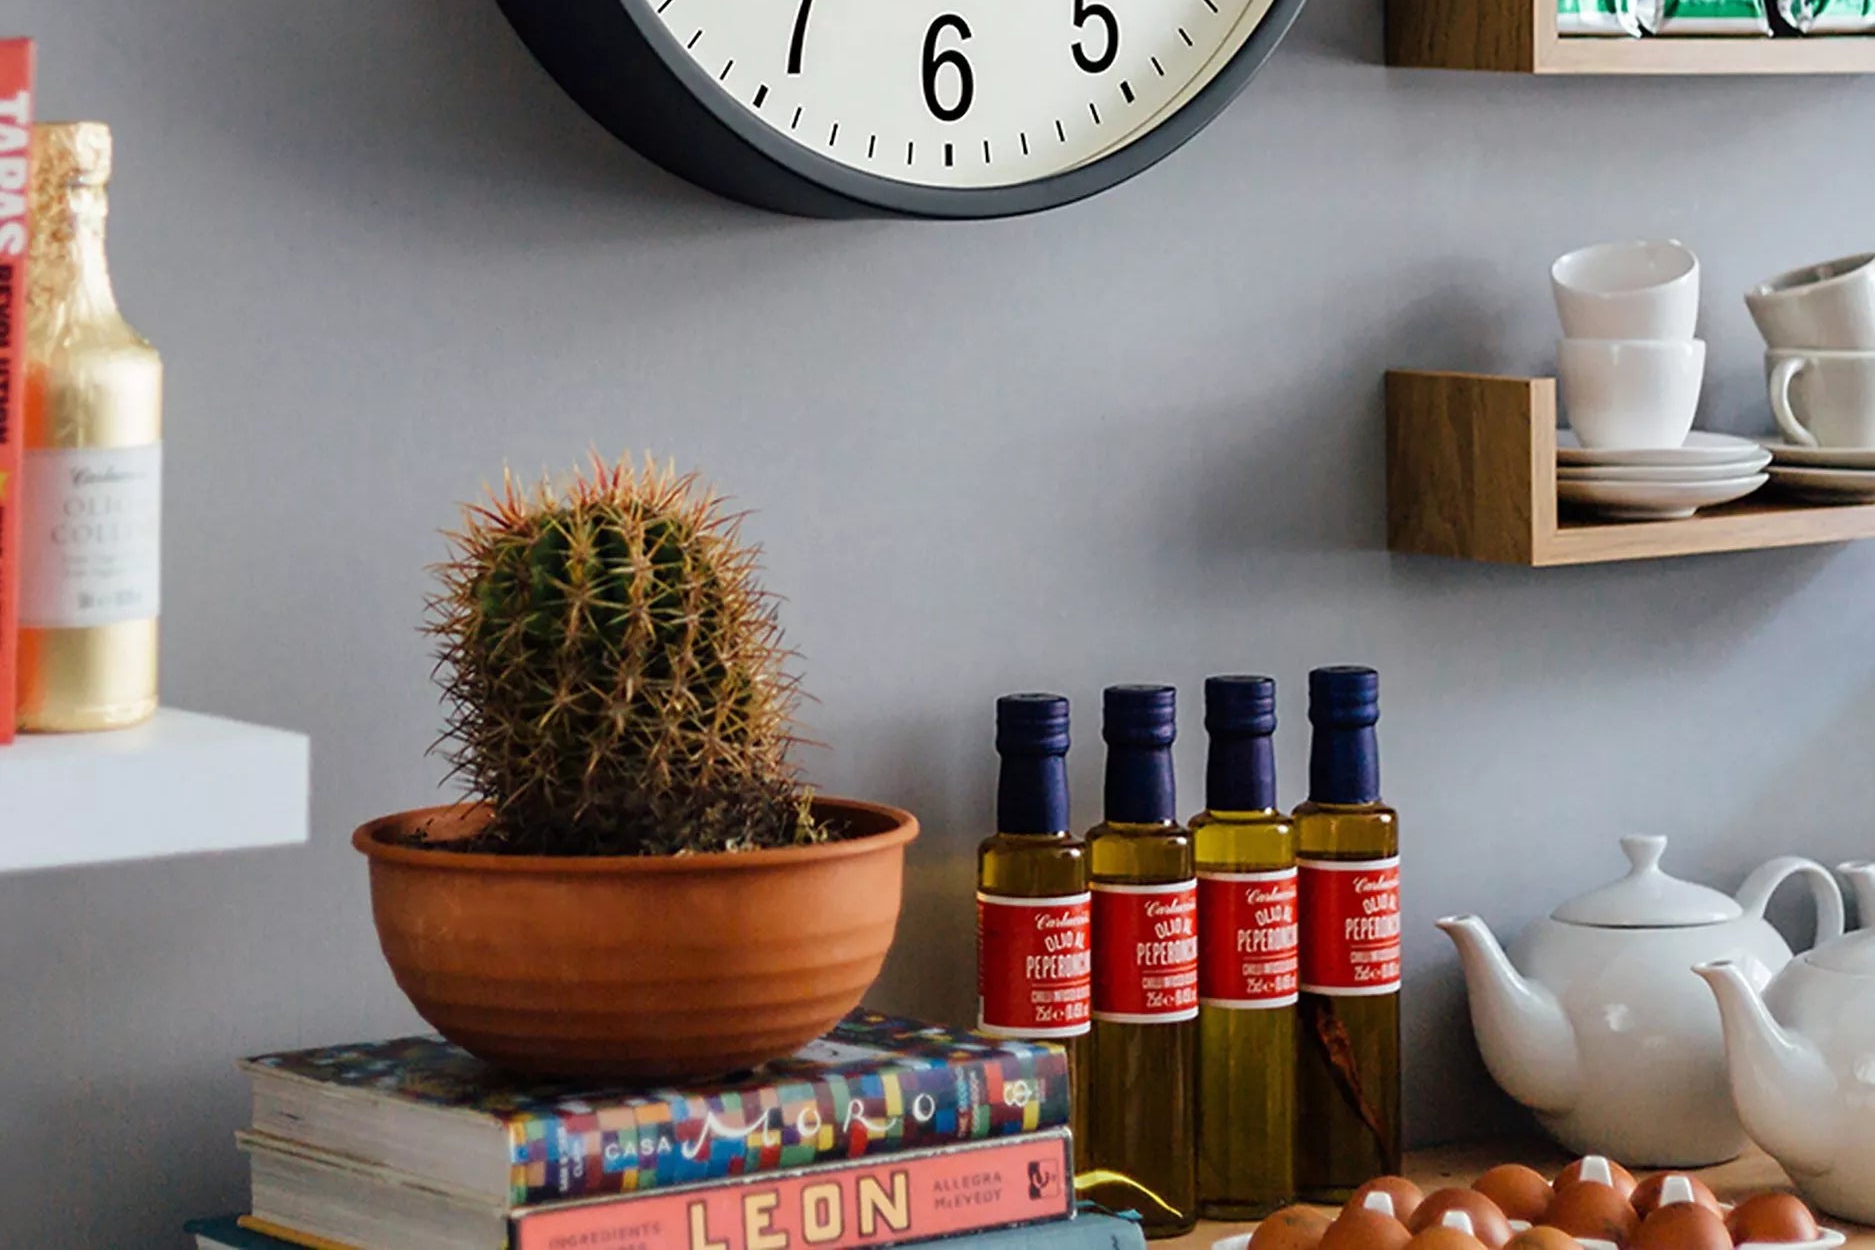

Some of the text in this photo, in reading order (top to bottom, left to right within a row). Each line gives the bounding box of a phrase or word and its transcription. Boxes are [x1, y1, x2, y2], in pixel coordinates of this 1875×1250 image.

[922, 13, 974, 122] 6
[604, 1136, 671, 1160] CASA
[681, 1093, 935, 1159] MORO
[933, 1171, 1002, 1192] ALLEGRA
[687, 1169, 911, 1250] LEON
[549, 1221, 662, 1248] INGREDIENTS
